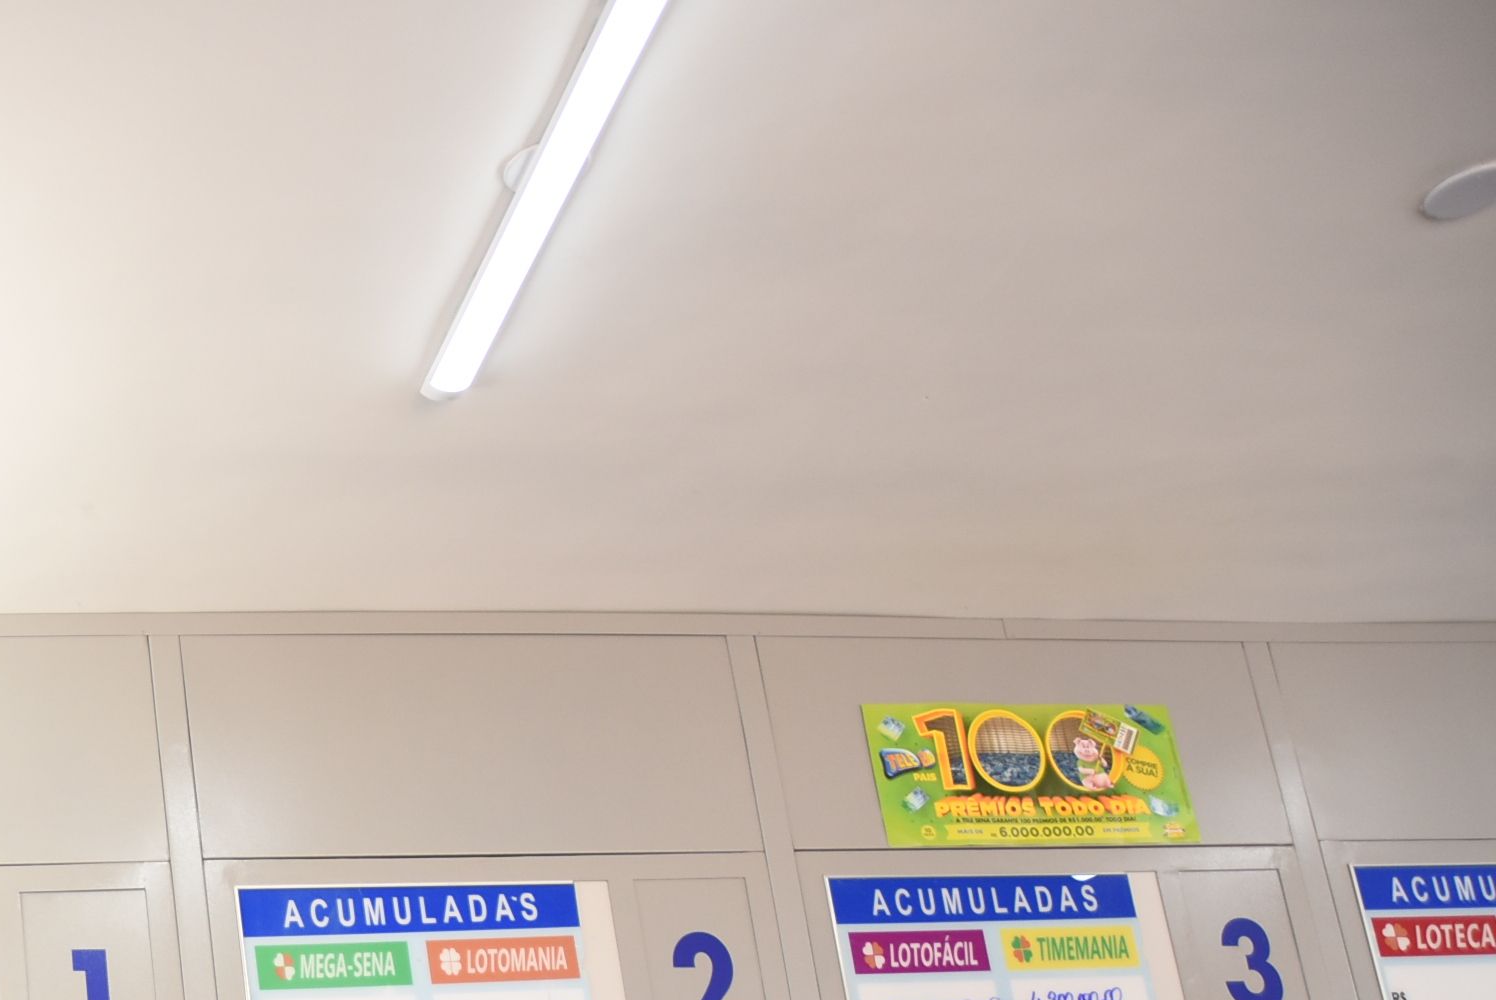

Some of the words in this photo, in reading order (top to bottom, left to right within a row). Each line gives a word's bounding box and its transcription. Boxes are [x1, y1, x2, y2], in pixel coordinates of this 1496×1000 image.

[912, 708, 1124, 792] 100
[934, 793, 1038, 818] PRÊMIOS
[1038, 796, 1105, 816] TODO
[1099, 795, 1152, 815] DIA
[999, 825, 1095, 839] 6.000.000,00
[284, 892, 540, 929] ACUMULADAS
[871, 883, 1100, 917] ACUMULADAS
[1036, 932, 1130, 963] TIMEMANIA
[1415, 923, 1496, 950] LOTECA
[299, 950, 396, 979] MEGA-SENA
[465, 945, 569, 975] LOTOMANIA
[889, 936, 979, 968] LOTOFÁCIL
